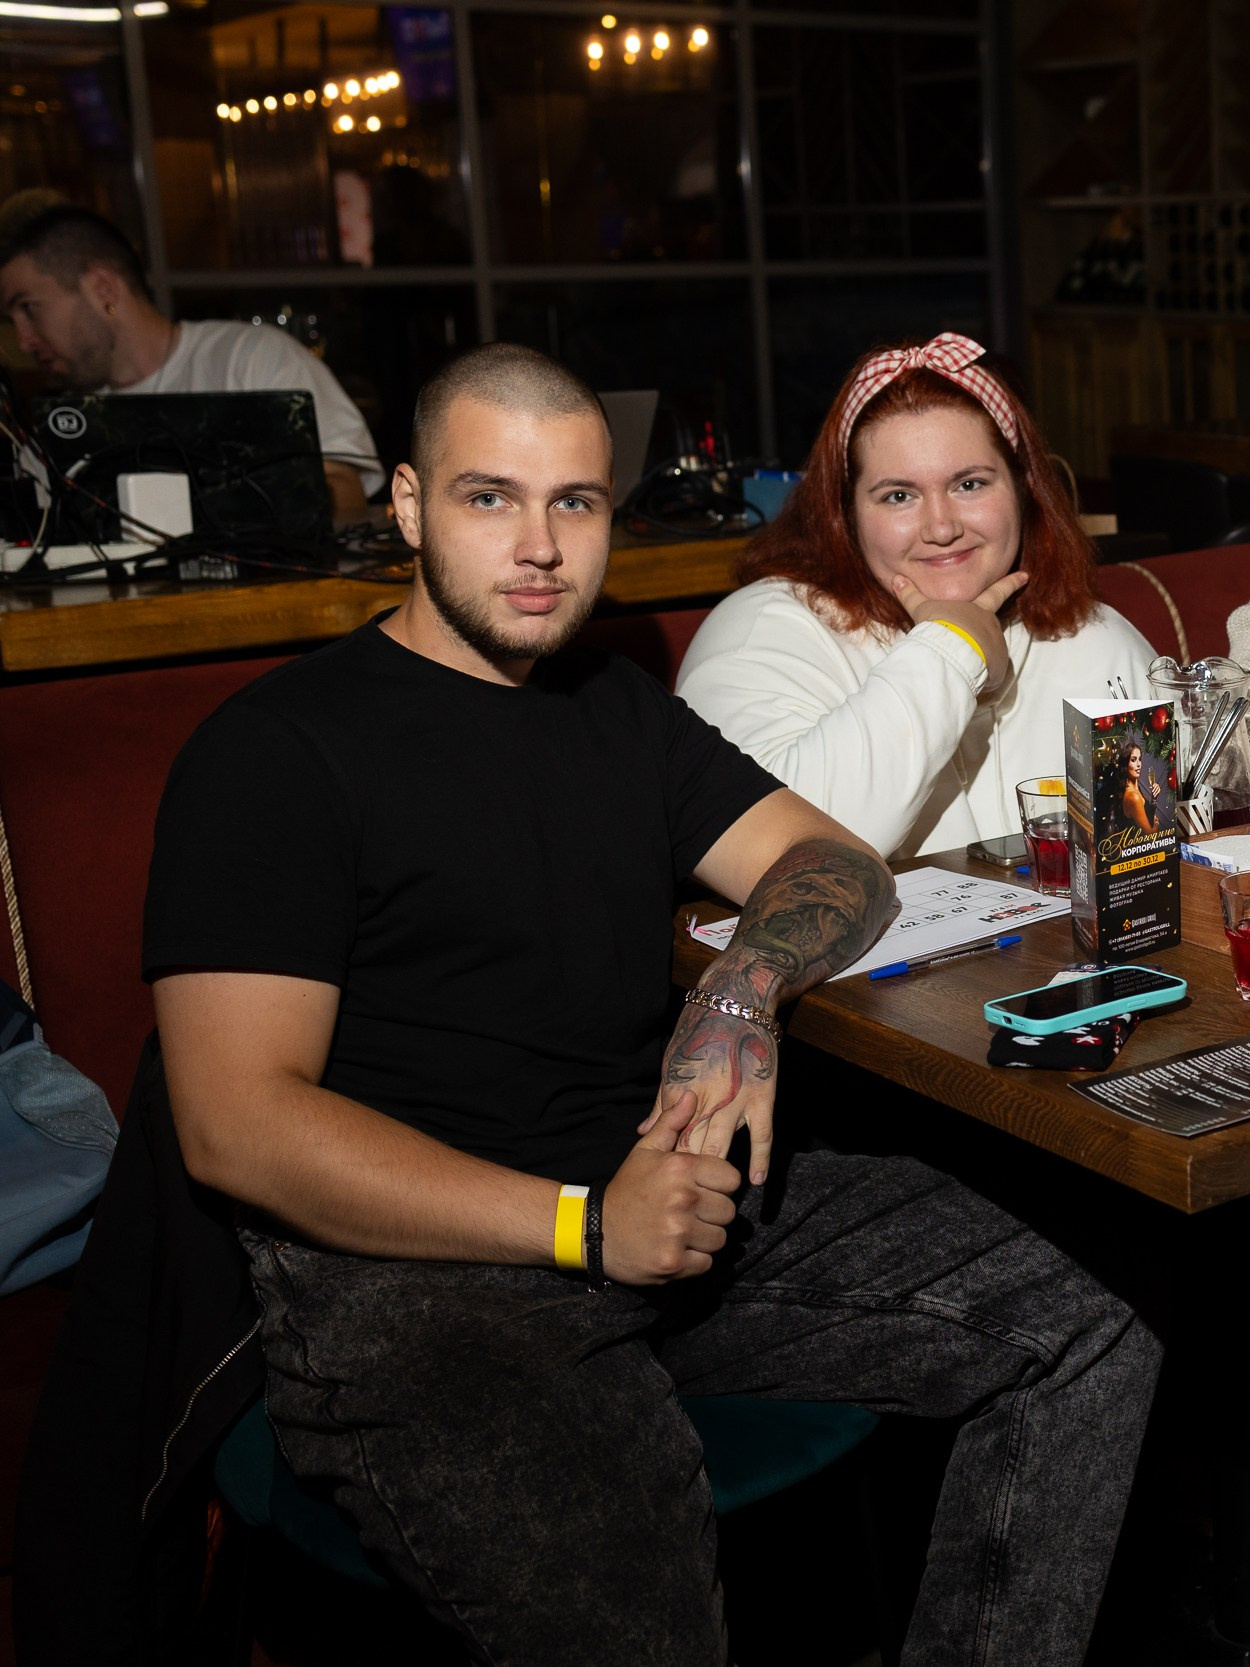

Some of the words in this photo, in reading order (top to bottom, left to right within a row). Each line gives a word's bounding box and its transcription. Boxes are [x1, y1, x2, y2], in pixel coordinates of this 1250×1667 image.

[1098, 826, 1176, 862] Новогодние
[1121, 836, 1176, 858] КОРПОРАТИВЫ
[1118, 862, 1133, 872] 12.12
[1133, 860, 1142, 868] по
[1142, 854, 1159, 865] 30.12
[957, 882, 978, 890] 88
[931, 889, 949, 897] 77
[1000, 892, 1018, 900] 87
[951, 894, 972, 902] 76
[951, 906, 968, 914] 67
[924, 913, 945, 921] 58
[899, 920, 920, 929] 42
